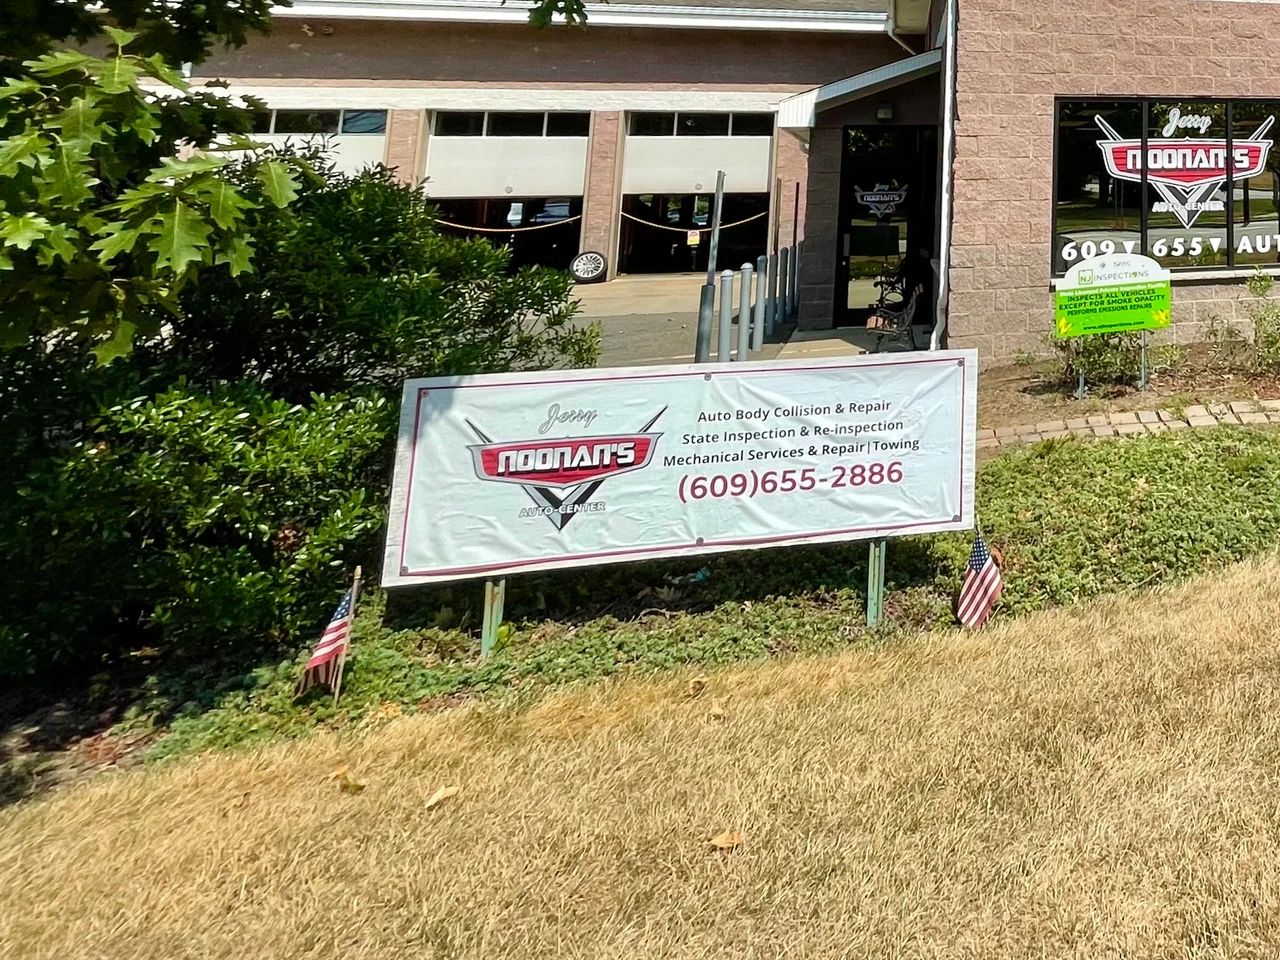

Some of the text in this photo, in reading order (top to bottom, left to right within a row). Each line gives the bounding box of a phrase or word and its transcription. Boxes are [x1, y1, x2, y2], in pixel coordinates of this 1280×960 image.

[1162, 107, 1212, 137] Jerry
[1061, 241, 1116, 260] 609
[1152, 237, 1202, 257] 655
[1059, 301, 1087, 310] EXCEPT
[1107, 297, 1132, 305] SMOKE
[1134, 294, 1166, 303] OPACITY
[1067, 293, 1103, 302] INSPECTS
[1105, 291, 1118, 299] ALL
[1121, 289, 1156, 298] VEHICLES
[538, 403, 600, 435] Jerry
[697, 400, 892, 424] Auto Body Collision & Repair
[682, 419, 904, 445] State Inspection & Re-inspection
[498, 443, 635, 473] NOONAN'S
[663, 450, 744, 467] Mechanical
[747, 447, 804, 461] Services
[808, 445, 818, 456] &
[678, 461, 905, 504] (609)655-2886
[519, 502, 606, 518] AUTO-CENTER
